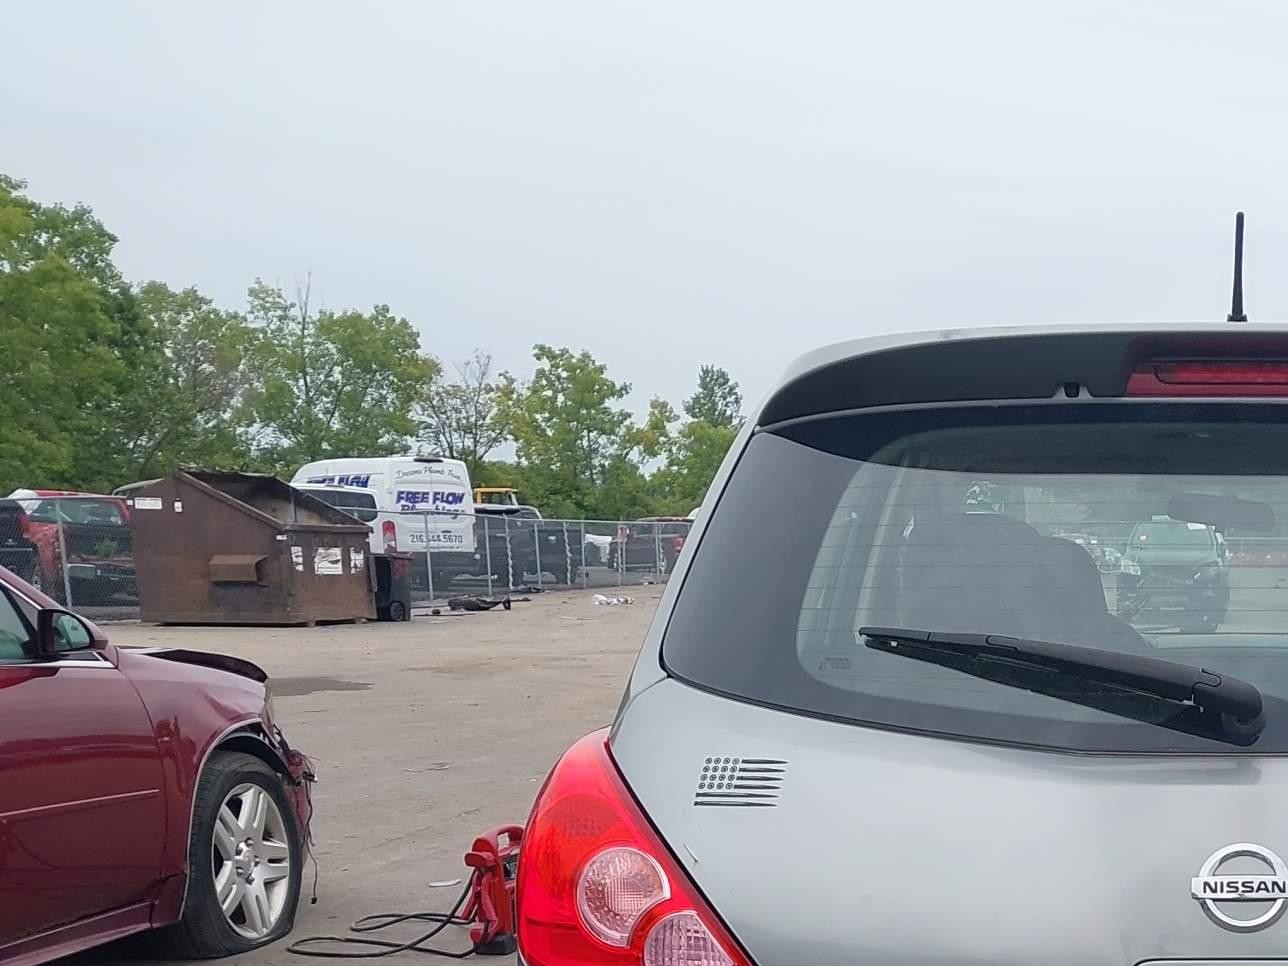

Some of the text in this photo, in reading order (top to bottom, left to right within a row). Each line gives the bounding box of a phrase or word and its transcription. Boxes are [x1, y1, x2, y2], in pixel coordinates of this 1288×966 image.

[396, 490, 466, 506] FREE FLOW
[1202, 880, 1287, 894] NISSAN
